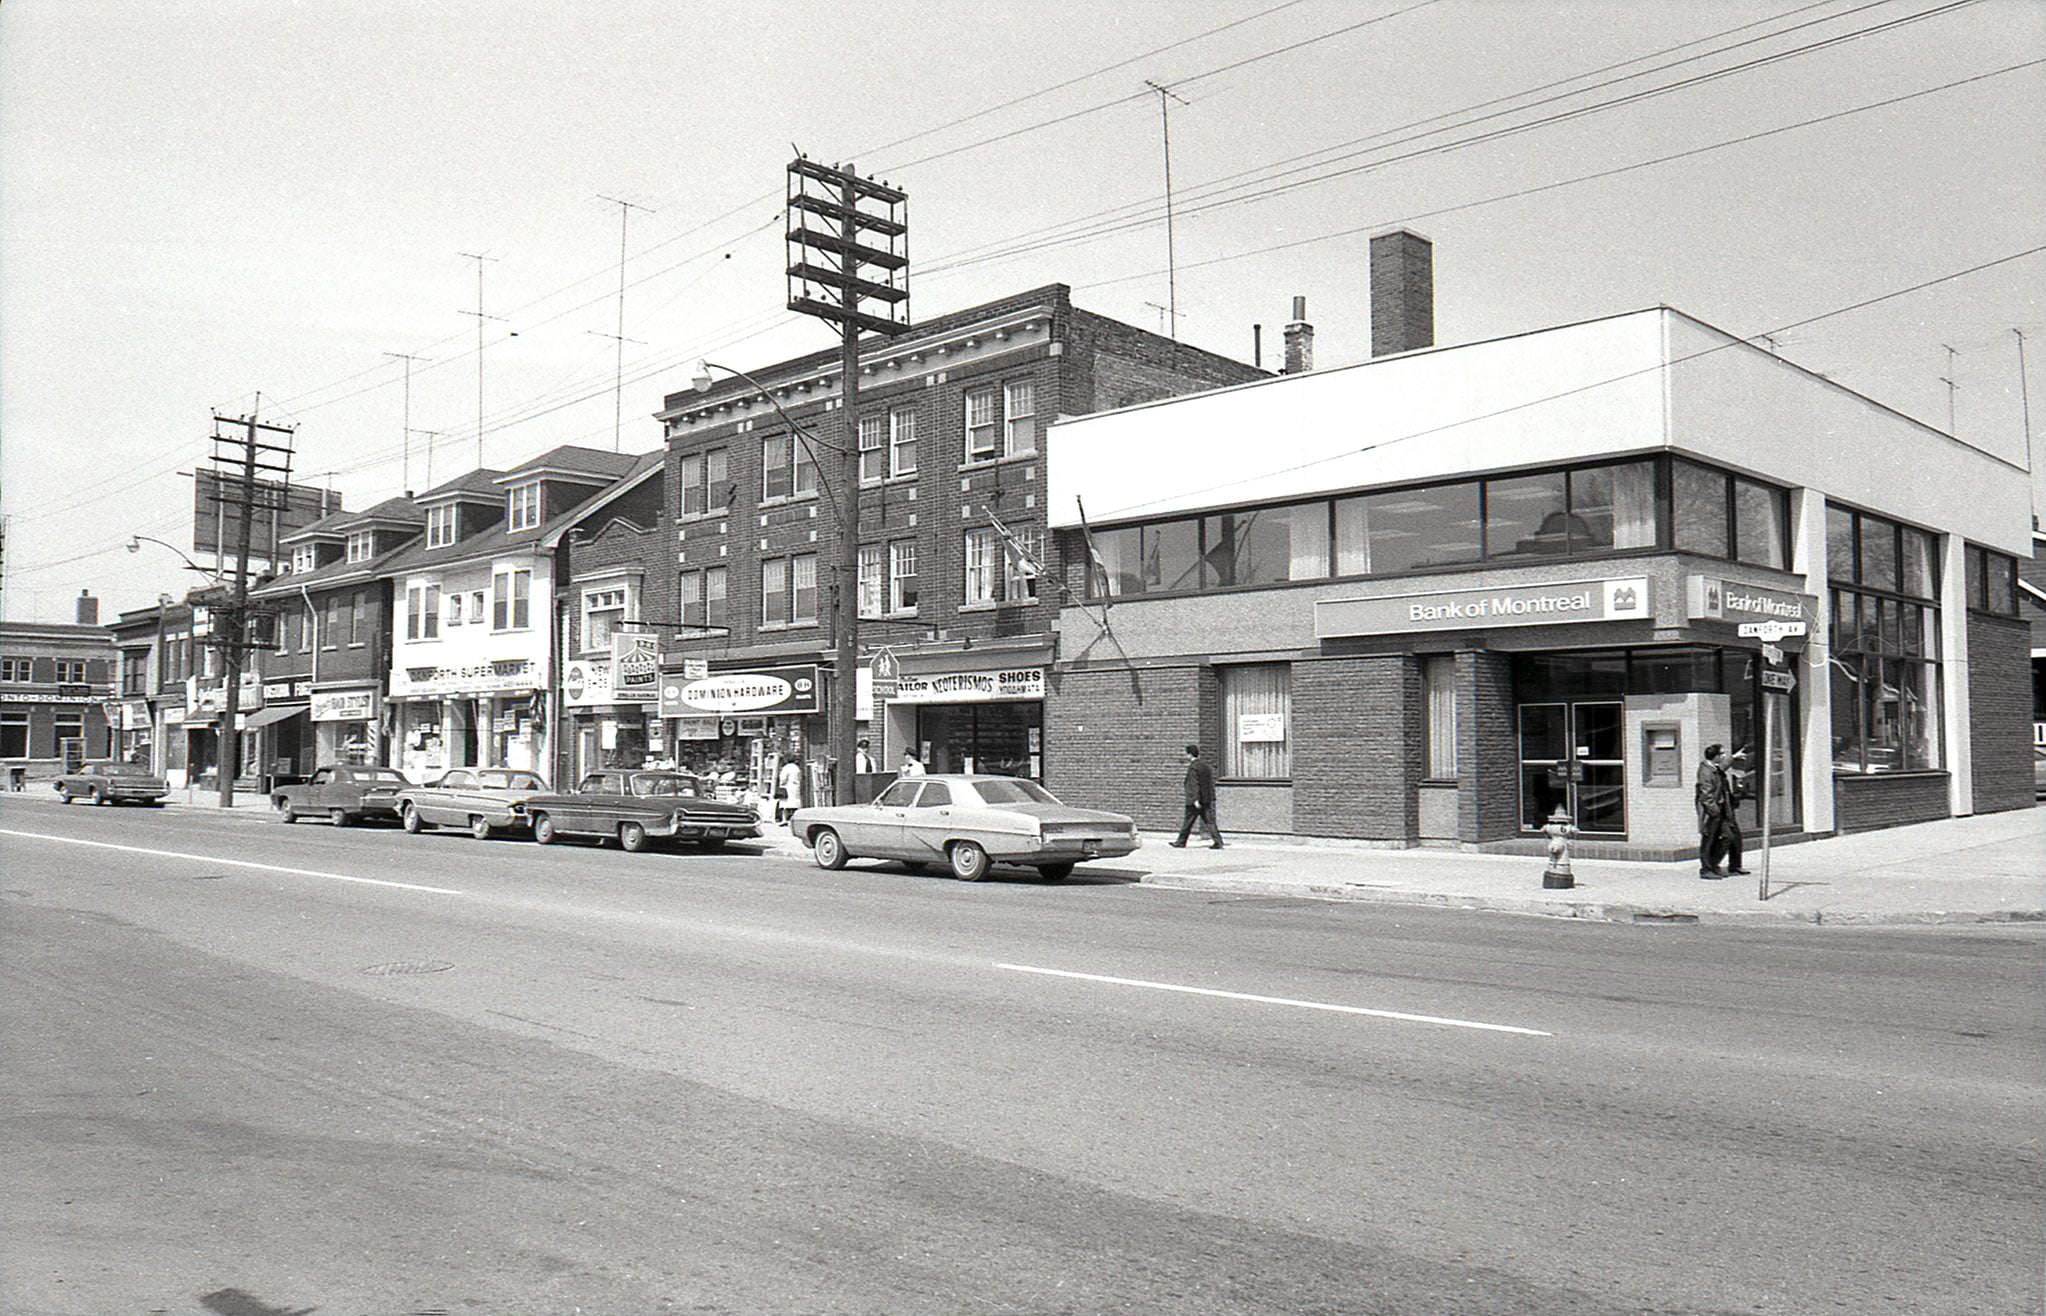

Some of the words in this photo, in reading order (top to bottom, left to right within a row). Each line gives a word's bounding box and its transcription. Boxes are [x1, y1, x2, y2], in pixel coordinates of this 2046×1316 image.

[1410, 602, 1463, 621] Bank
[1465, 600, 1489, 617] of
[1491, 591, 1590, 616] Montreal
[1726, 591, 1752, 611] Bank
[1763, 598, 1802, 618] Montreal
[1743, 625, 1783, 635] DANFORTH
[410, 668, 457, 682] DANFORTH
[461, 661, 536, 678] SUPERMARKET
[999, 670, 1041, 684] SHOES
[1763, 672, 1776, 685] ONE
[687, 687, 733, 700] DOMINION
[733, 684, 783, 698] HARDWARE
[899, 682, 928, 692] AILOR
[932, 675, 993, 694] NEOTERISMOS
